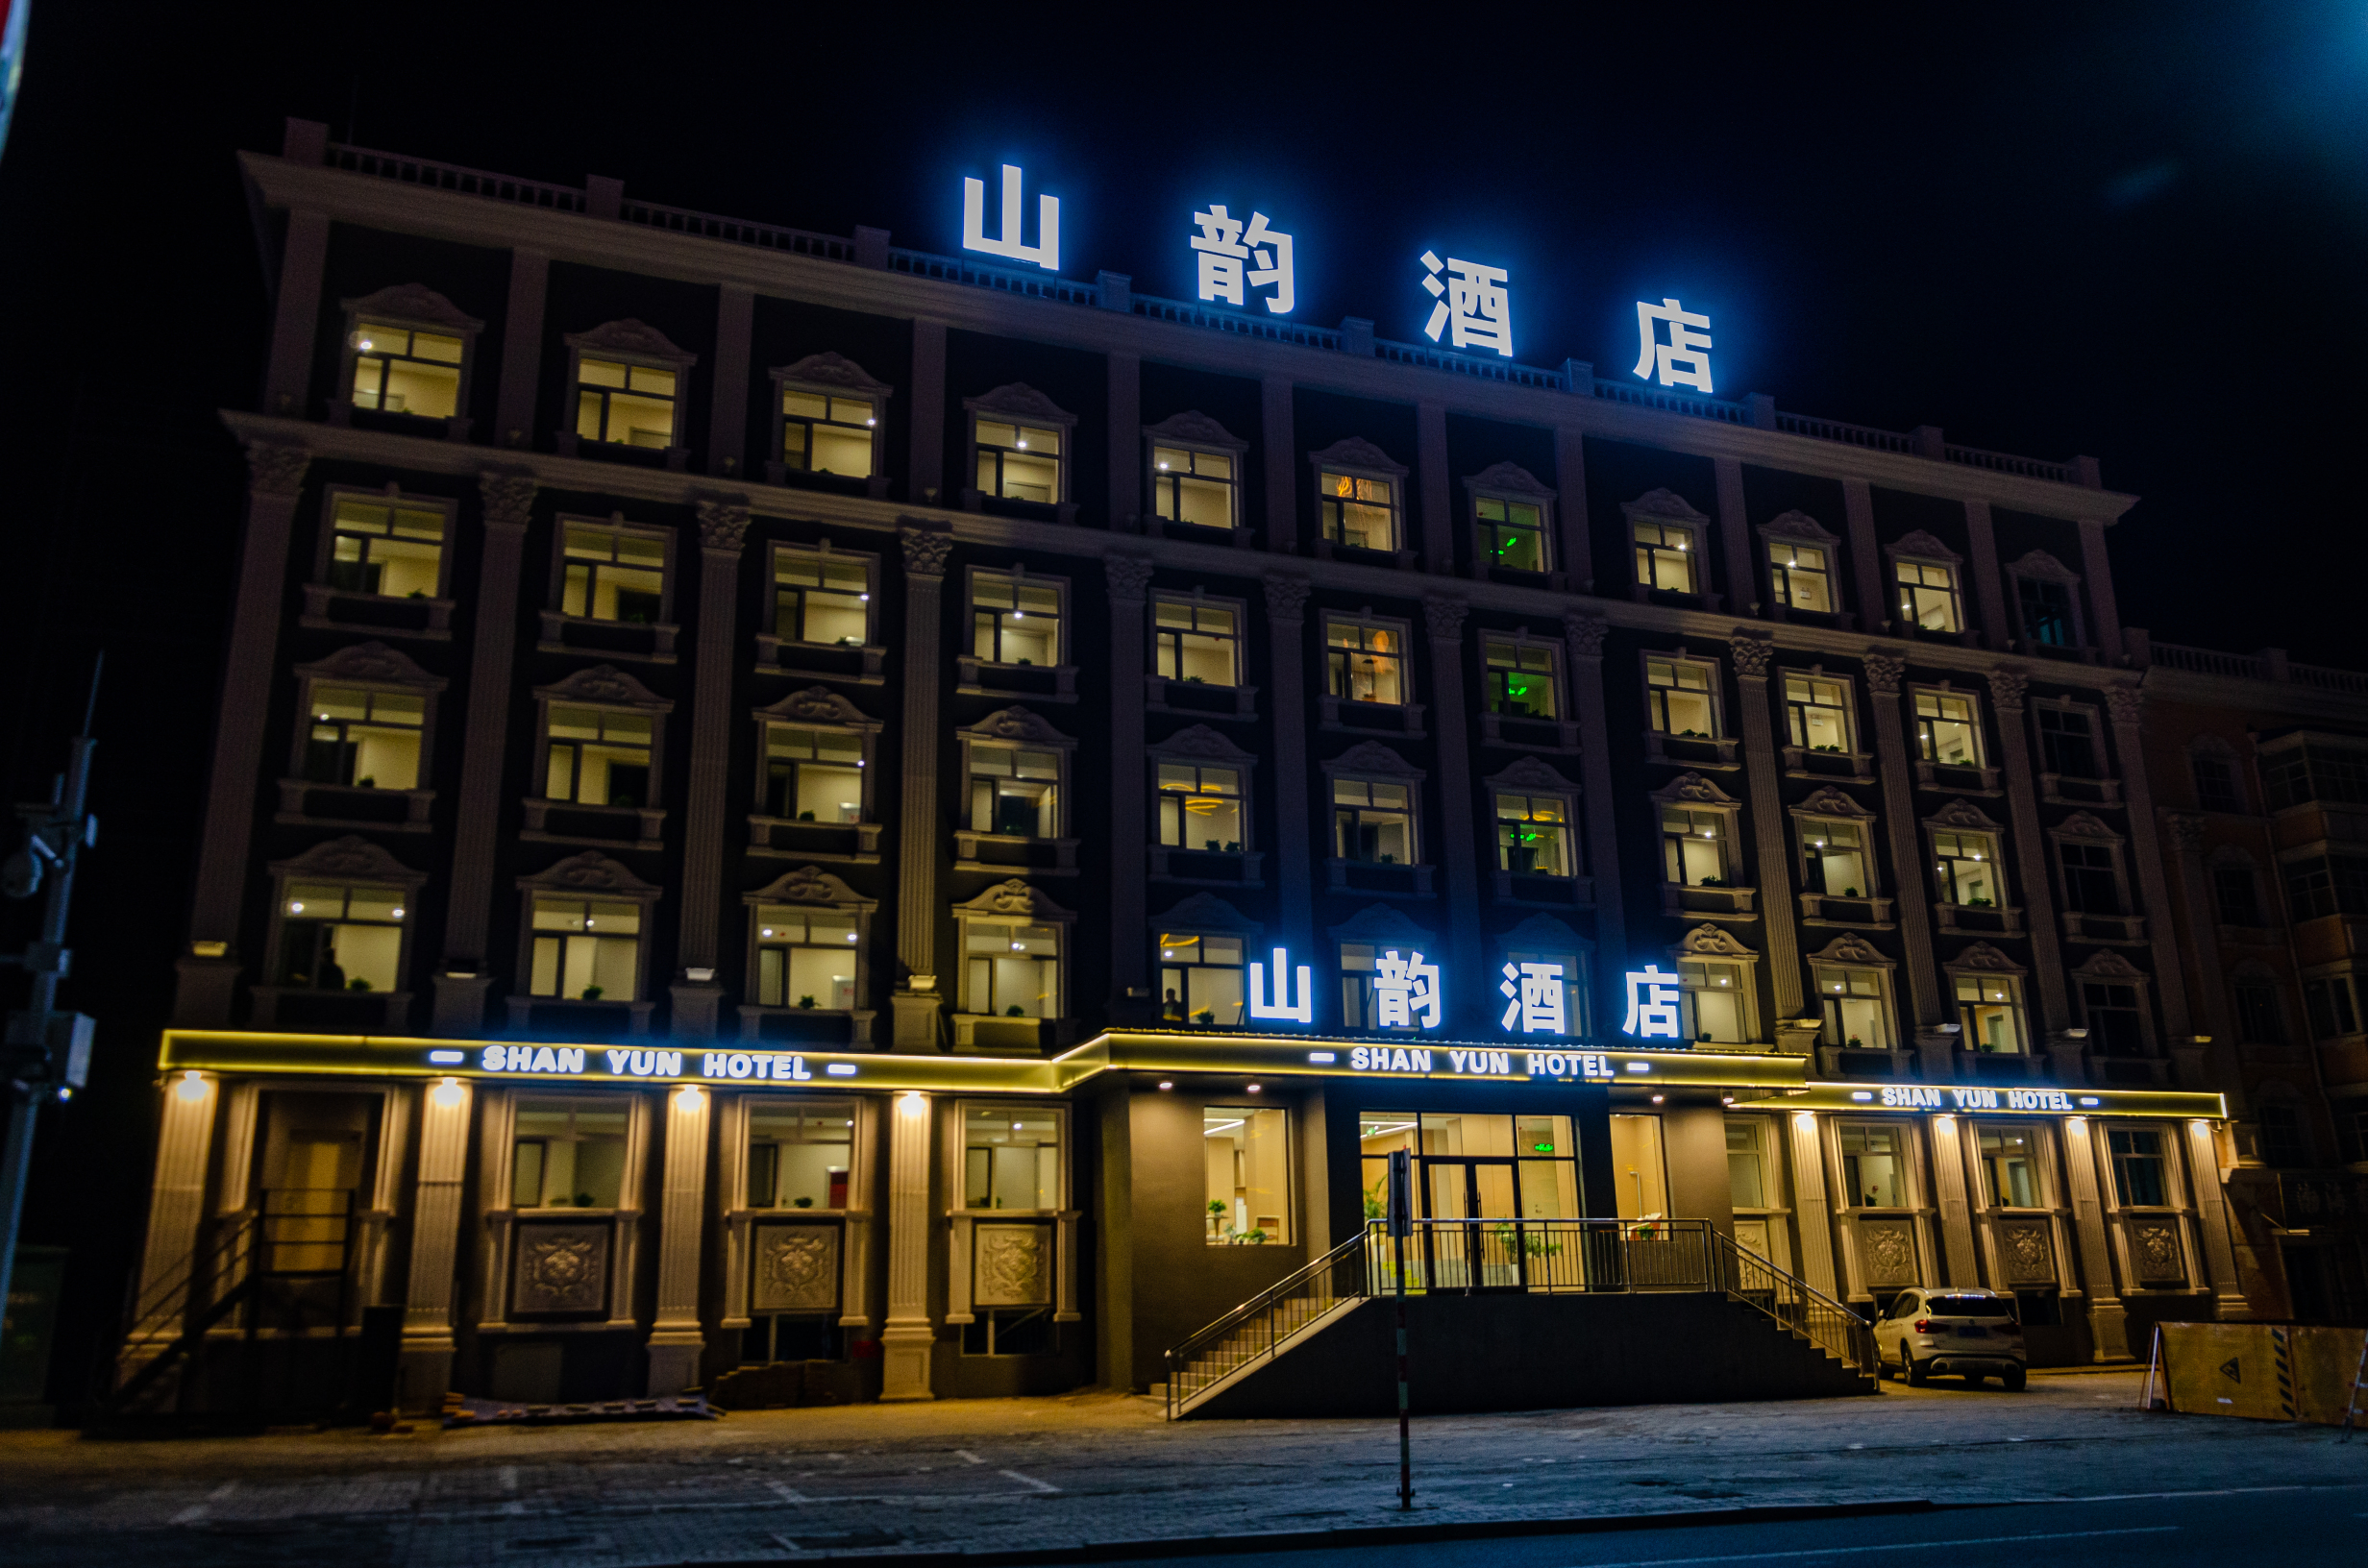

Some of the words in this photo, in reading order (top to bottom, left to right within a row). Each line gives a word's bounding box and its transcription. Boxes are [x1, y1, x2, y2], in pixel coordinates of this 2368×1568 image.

[962, 163, 1714, 394] 山韵酒店
[1248, 946, 1681, 1040] 山韵酒店
[481, 1044, 585, 1073] SHAN
[606, 1049, 682, 1077] YUN
[703, 1052, 812, 1081] HOTEL
[1350, 1046, 1432, 1072] SHAN
[1448, 1050, 1510, 1075] YUN
[1526, 1053, 1615, 1078] HOTEL
[1882, 1087, 1941, 1107] SHAN
[1952, 1089, 1999, 1109] YUN
[2008, 1090, 2074, 1111] HOTEL
